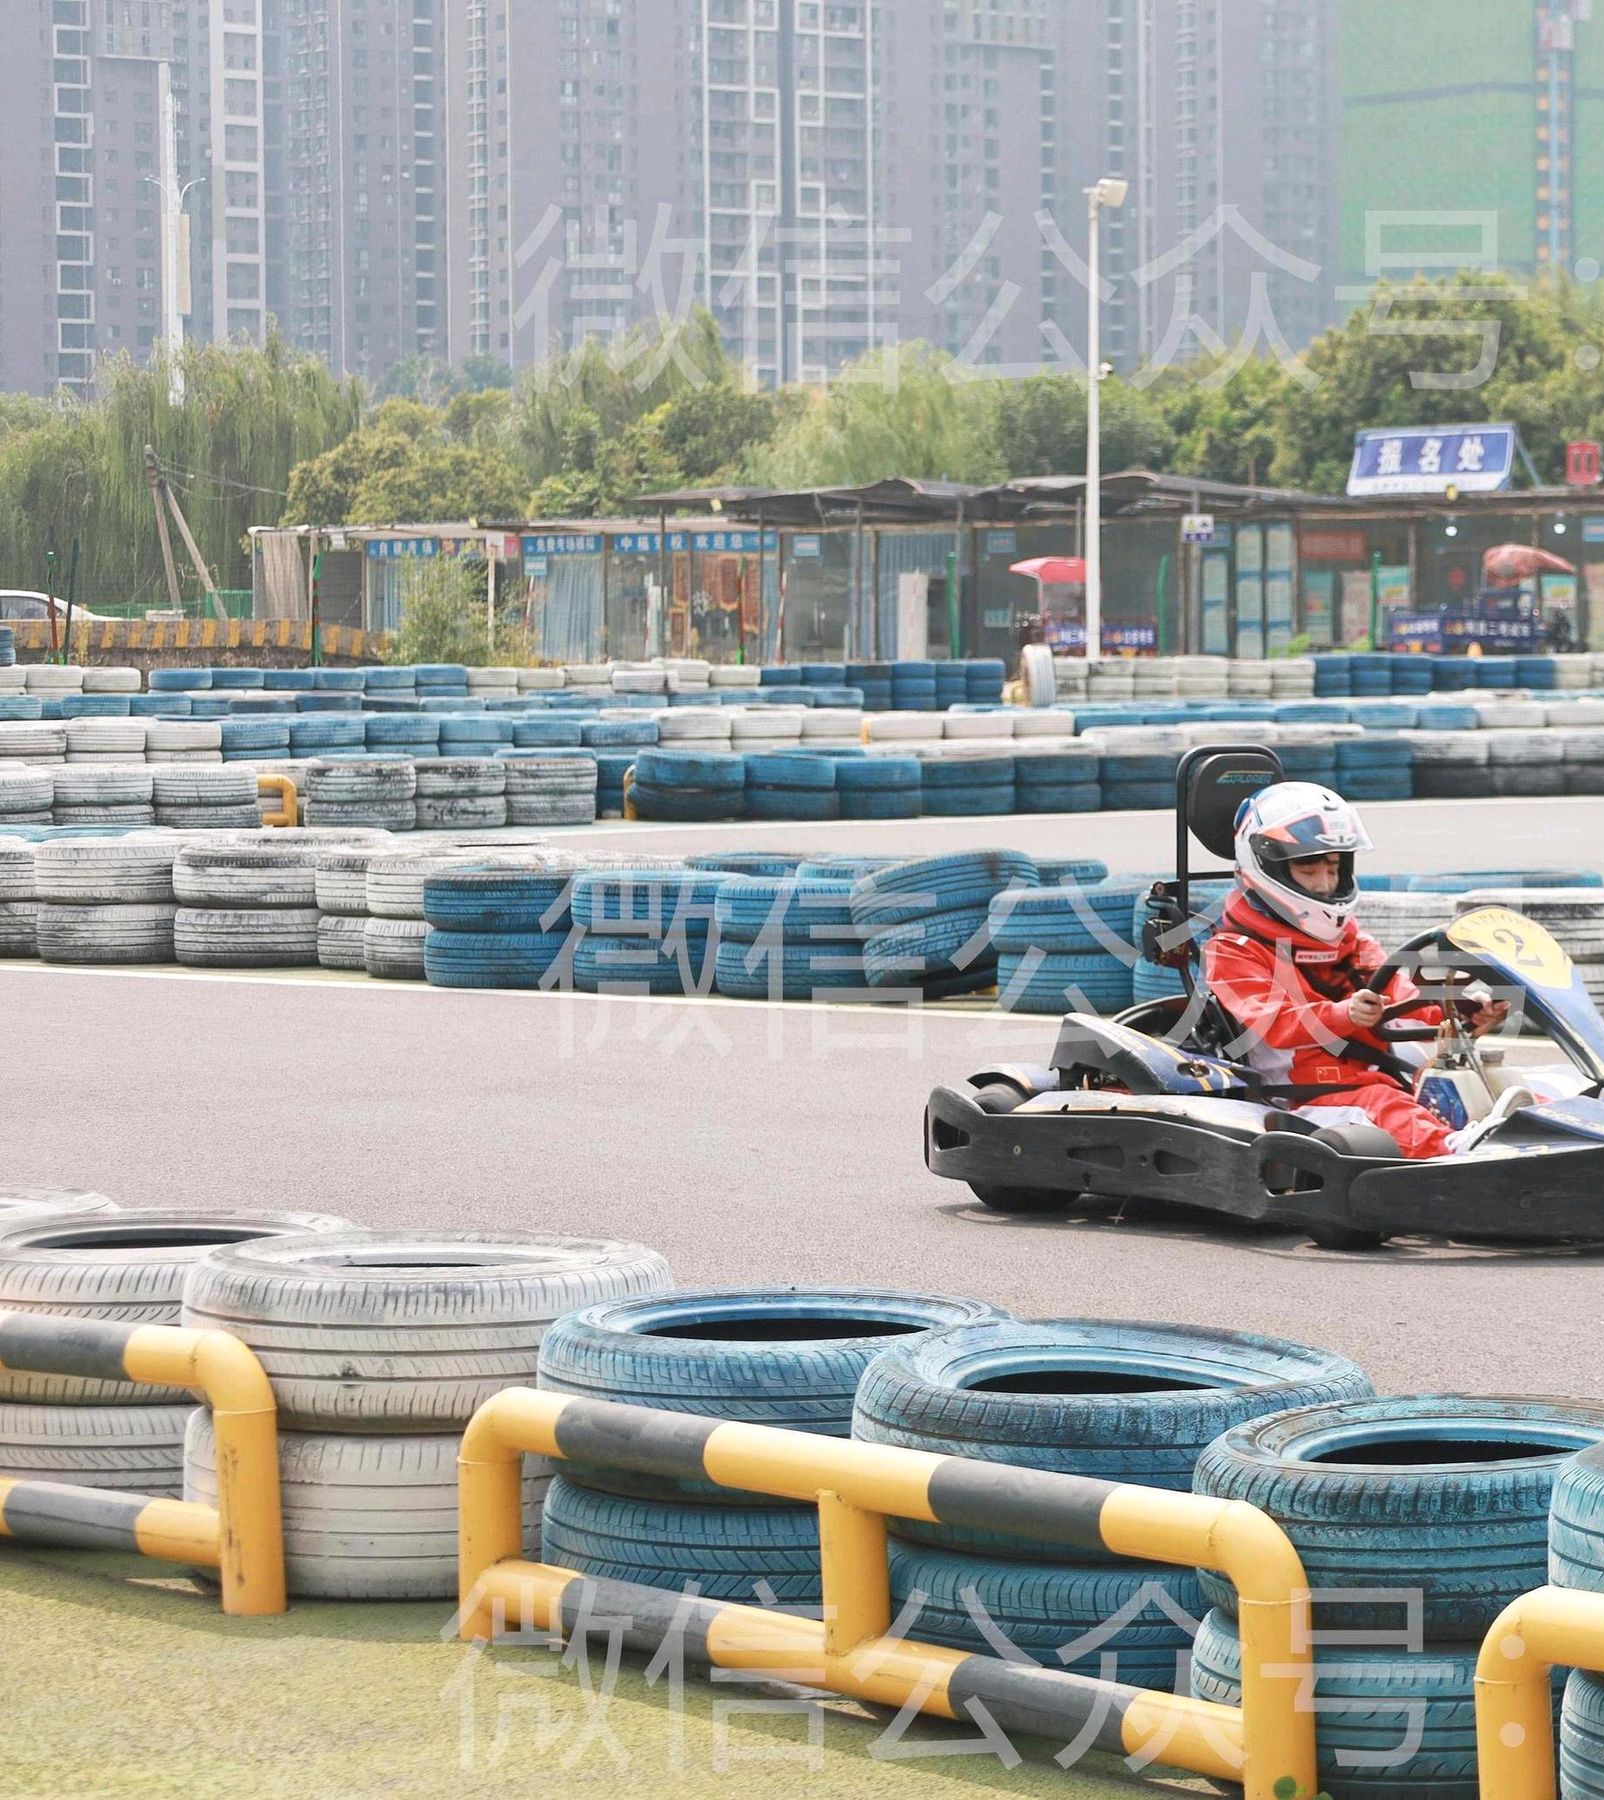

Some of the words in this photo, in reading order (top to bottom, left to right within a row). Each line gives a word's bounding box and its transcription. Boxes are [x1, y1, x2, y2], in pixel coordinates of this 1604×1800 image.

[1377, 436, 1486, 475] 报名处
[1492, 928, 1545, 967] 2
